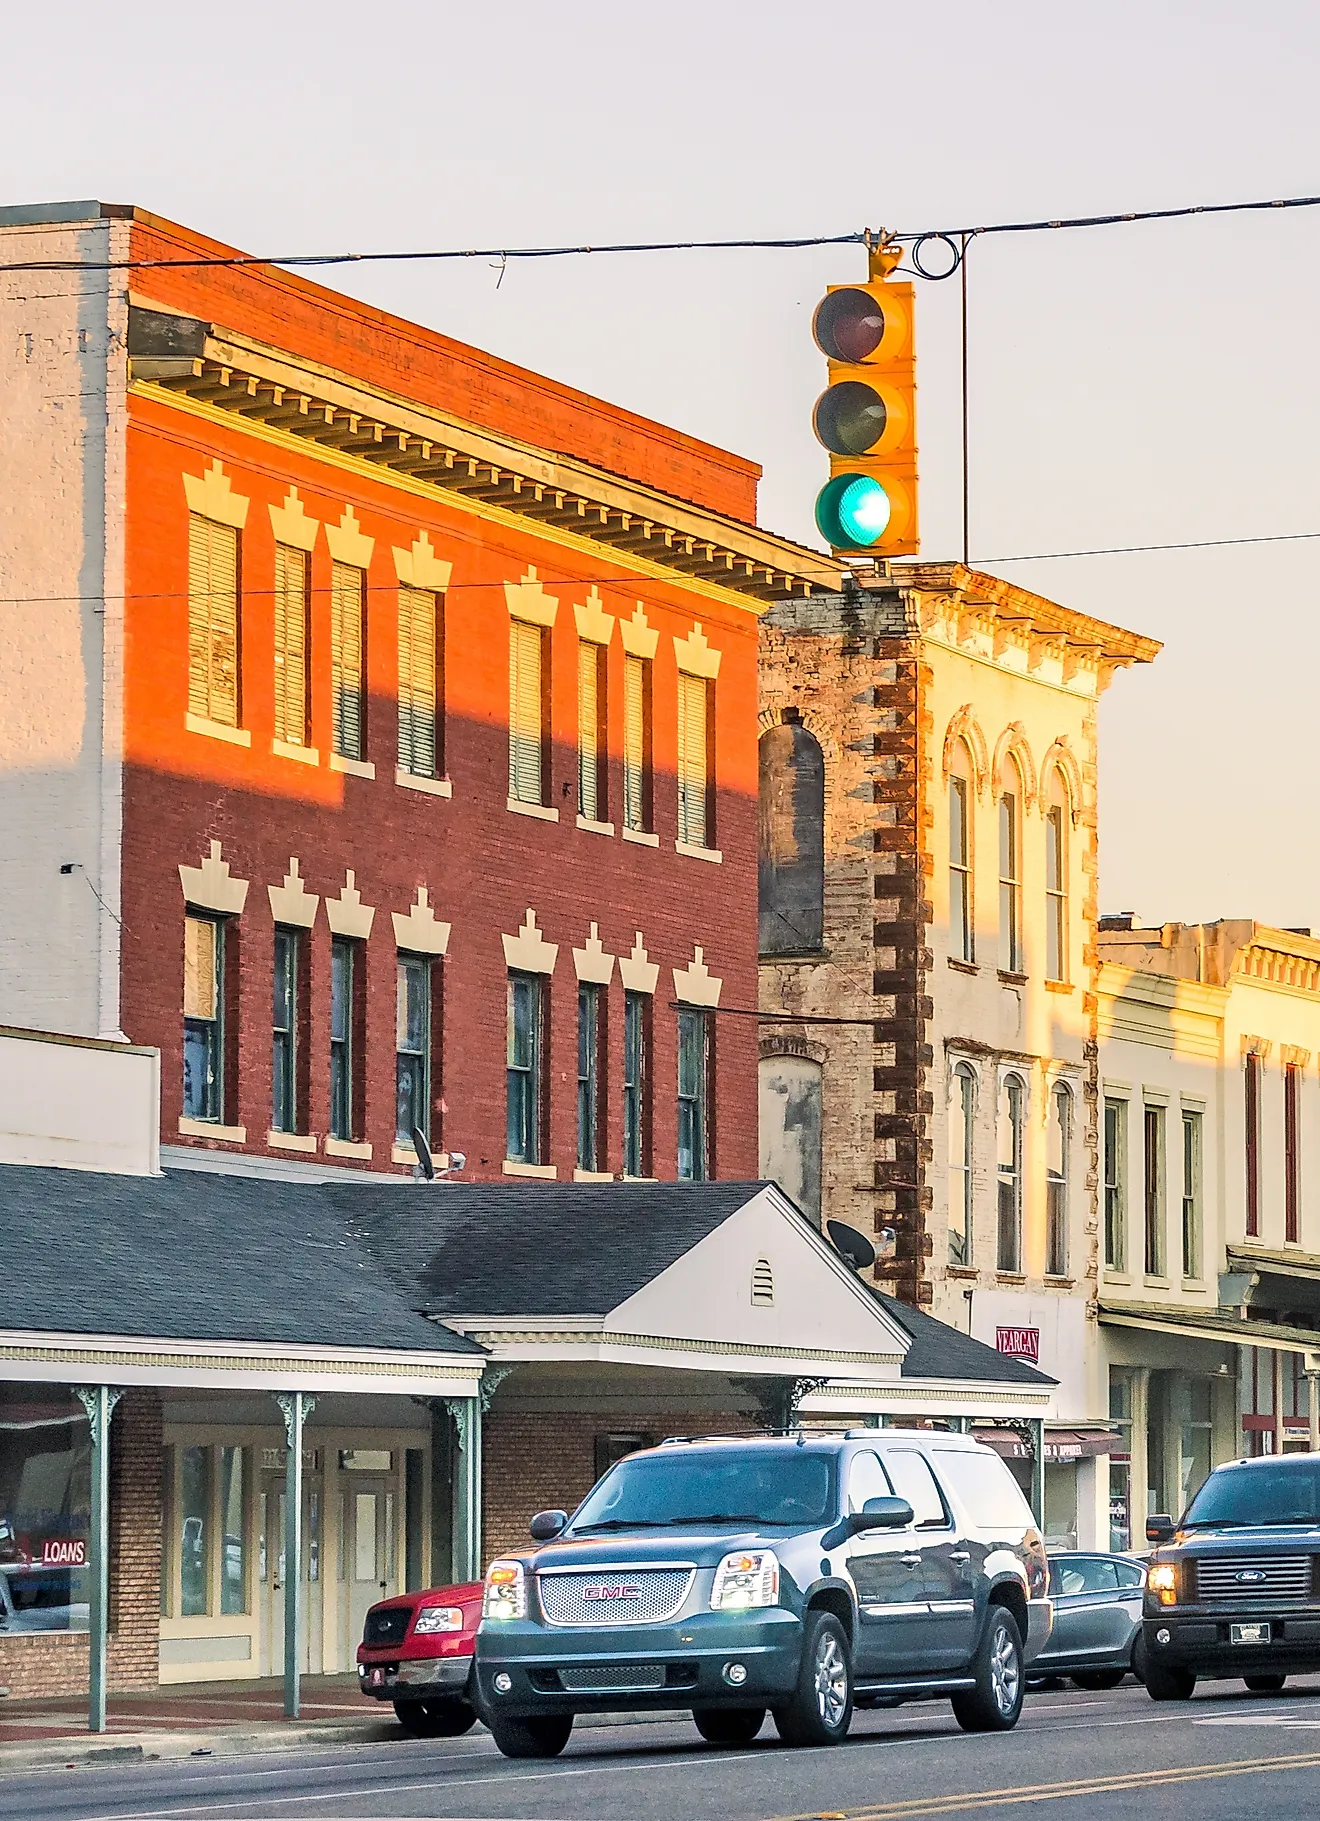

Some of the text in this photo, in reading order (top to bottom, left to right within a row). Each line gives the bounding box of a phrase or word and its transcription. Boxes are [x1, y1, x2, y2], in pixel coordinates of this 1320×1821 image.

[997, 1331, 1038, 1357] YEARGAN
[43, 1541, 85, 1562] LOANS
[584, 1585, 642, 1600] GMC
